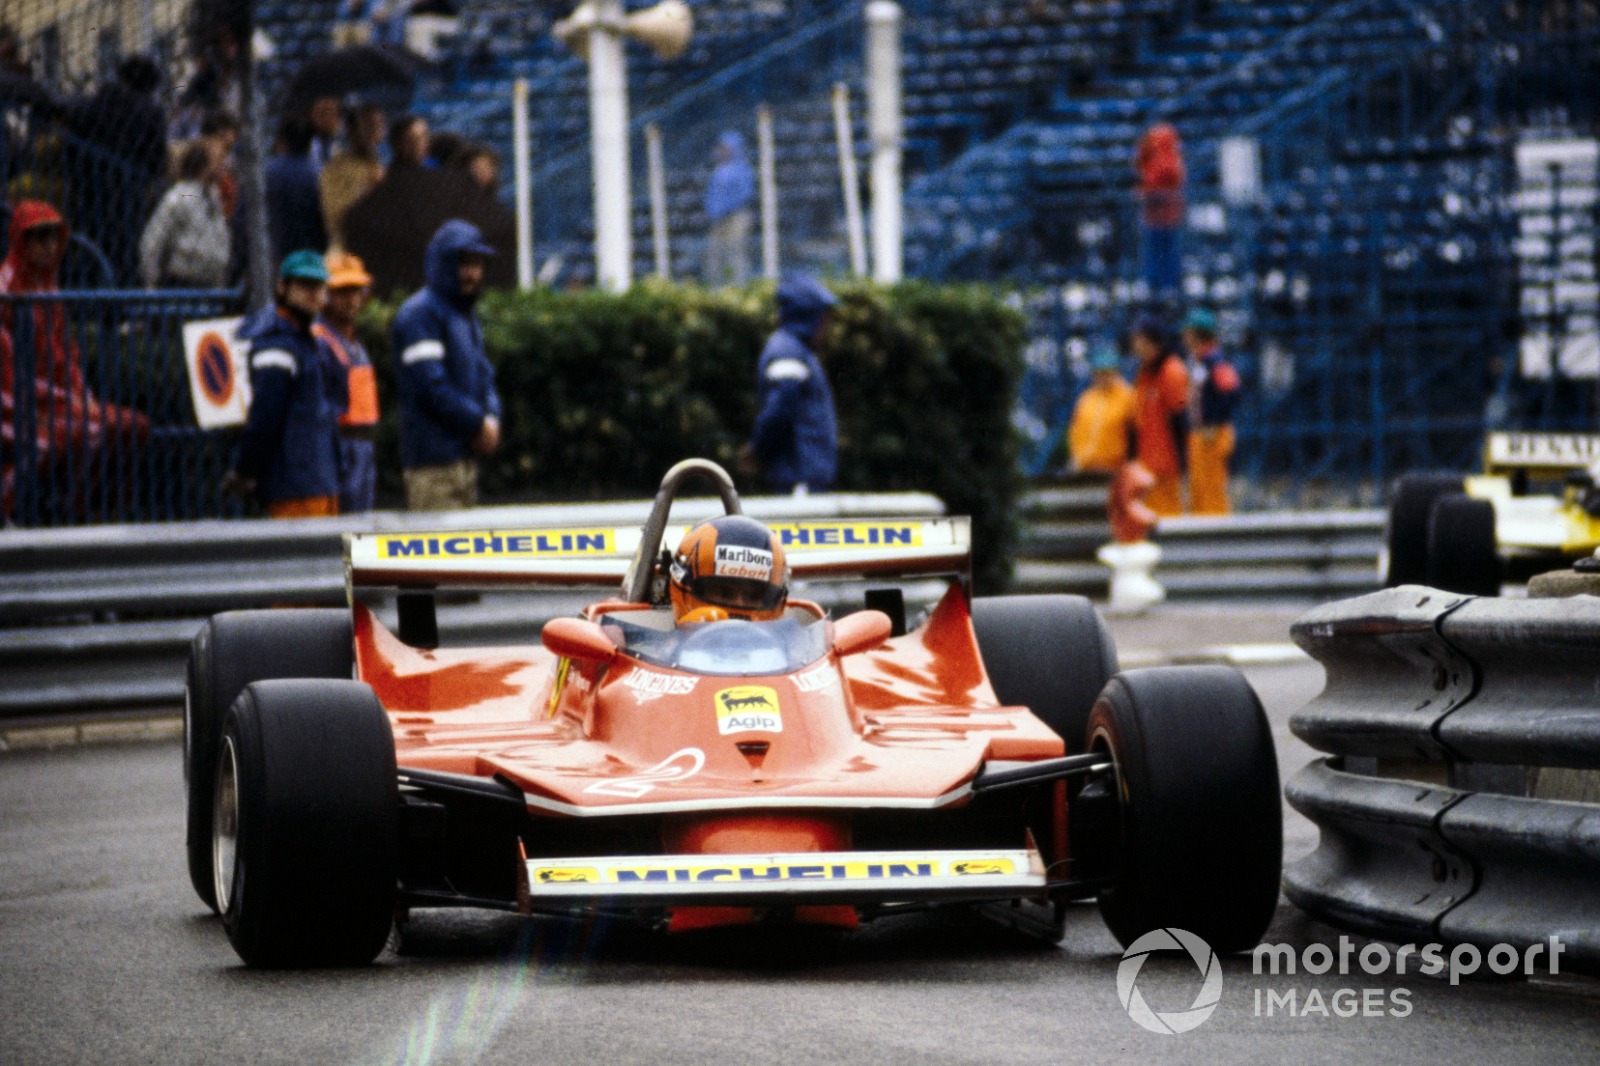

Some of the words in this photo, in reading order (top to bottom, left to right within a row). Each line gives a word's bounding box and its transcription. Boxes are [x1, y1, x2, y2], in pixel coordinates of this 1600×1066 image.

[387, 533, 605, 557] MICHELIN
[773, 528, 911, 545] HELIN
[717, 547, 772, 567] Marlboro
[727, 715, 776, 730] Agip
